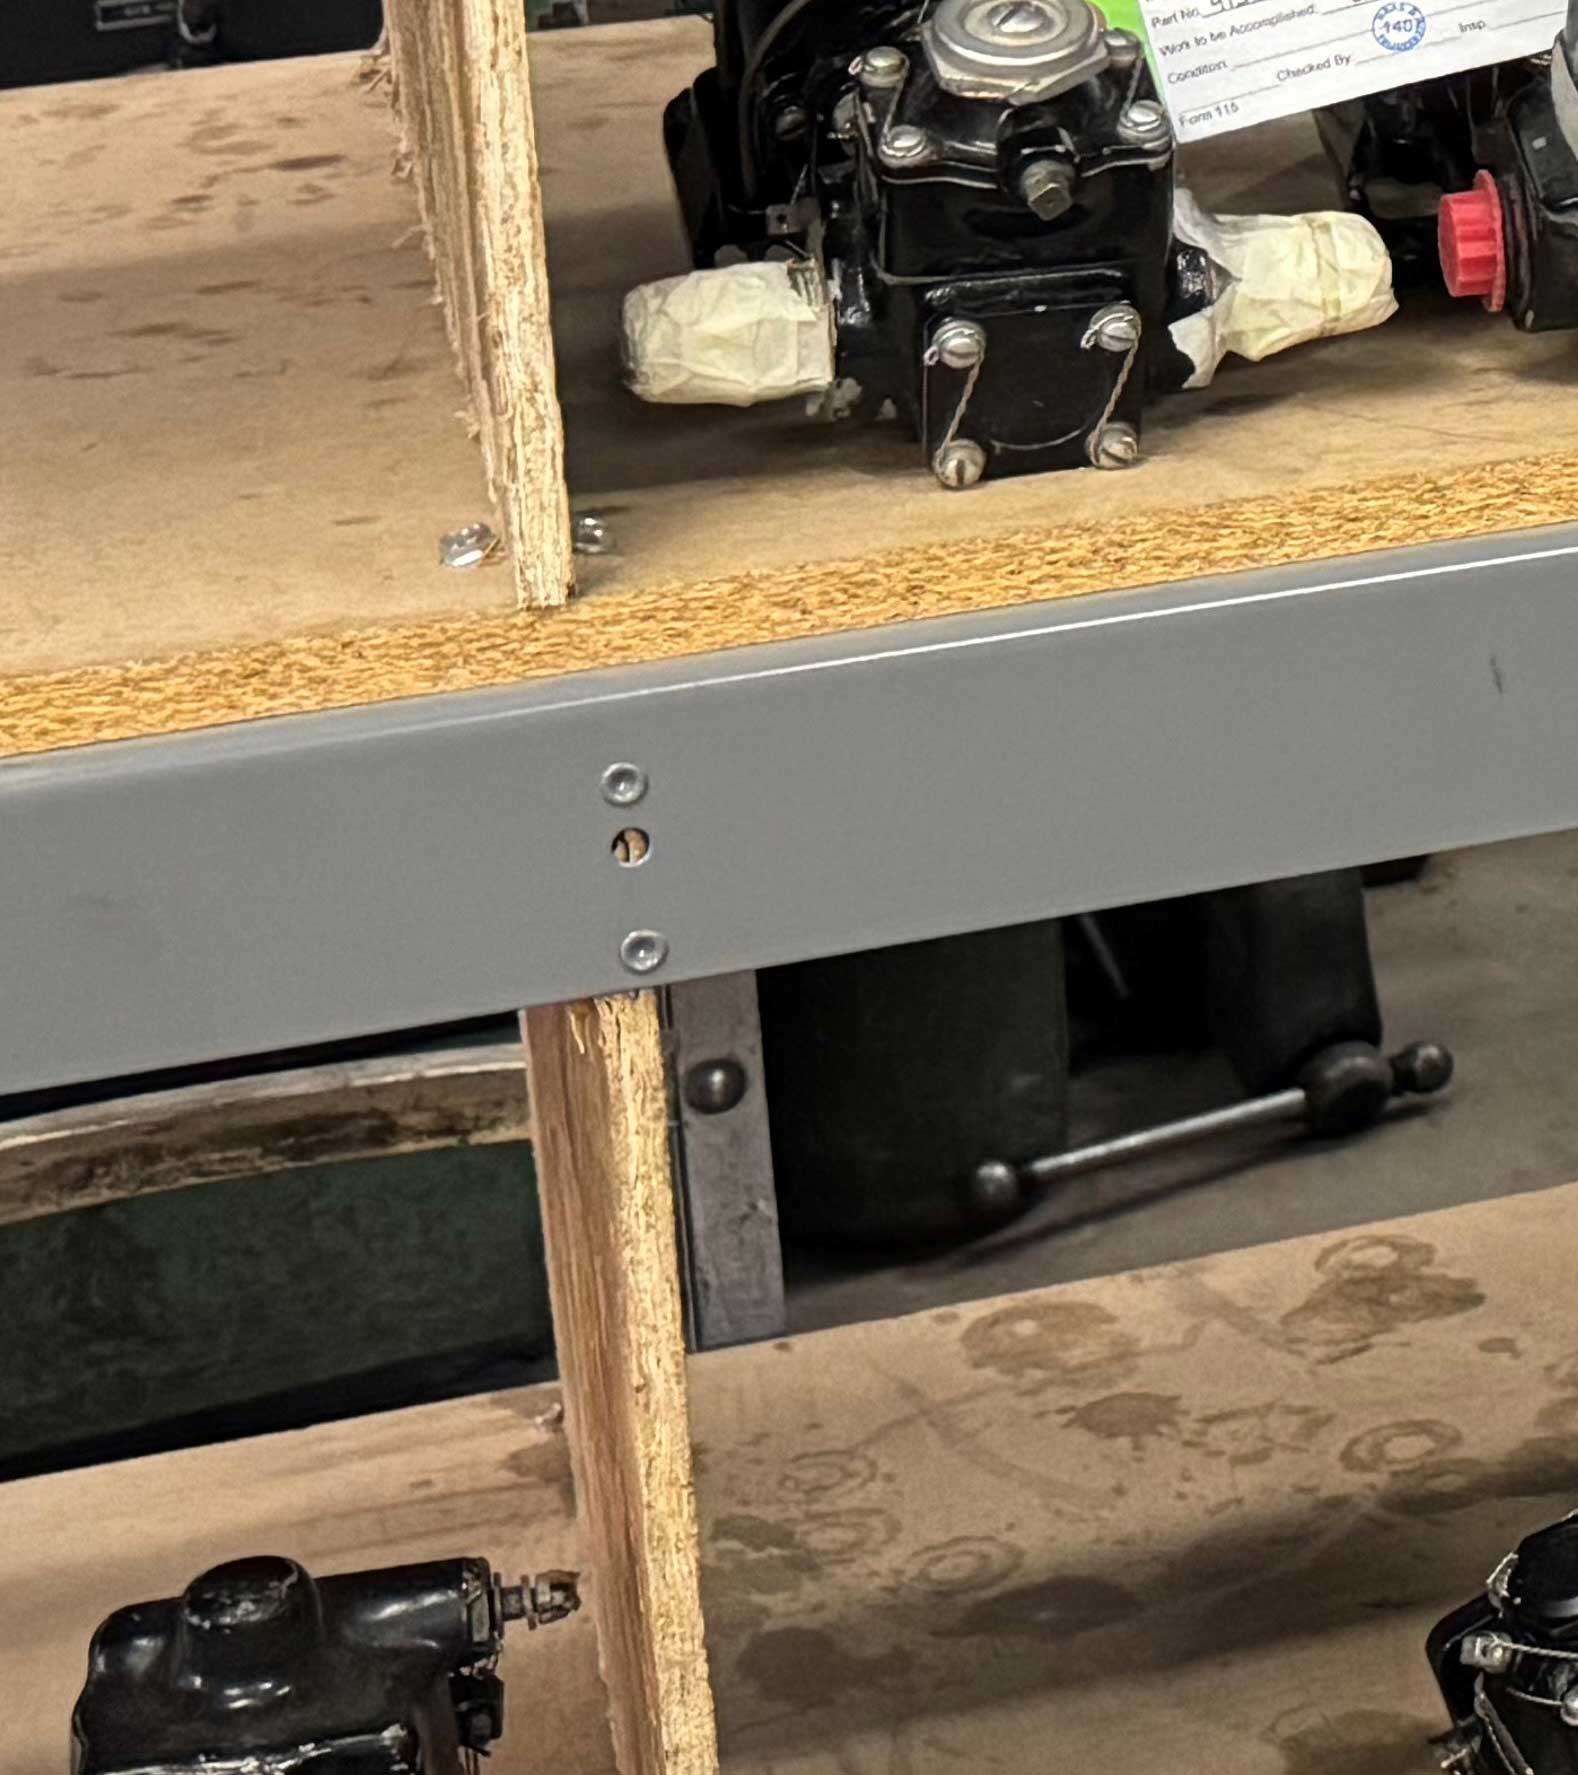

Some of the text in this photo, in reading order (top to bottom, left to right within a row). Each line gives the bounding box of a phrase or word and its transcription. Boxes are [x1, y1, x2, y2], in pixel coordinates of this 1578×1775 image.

[1159, 42, 1191, 57] Work
[1194, 35, 1208, 47] to
[1209, 29, 1226, 43] be
[1335, 52, 1352, 67] By
[1179, 108, 1213, 126] Form
